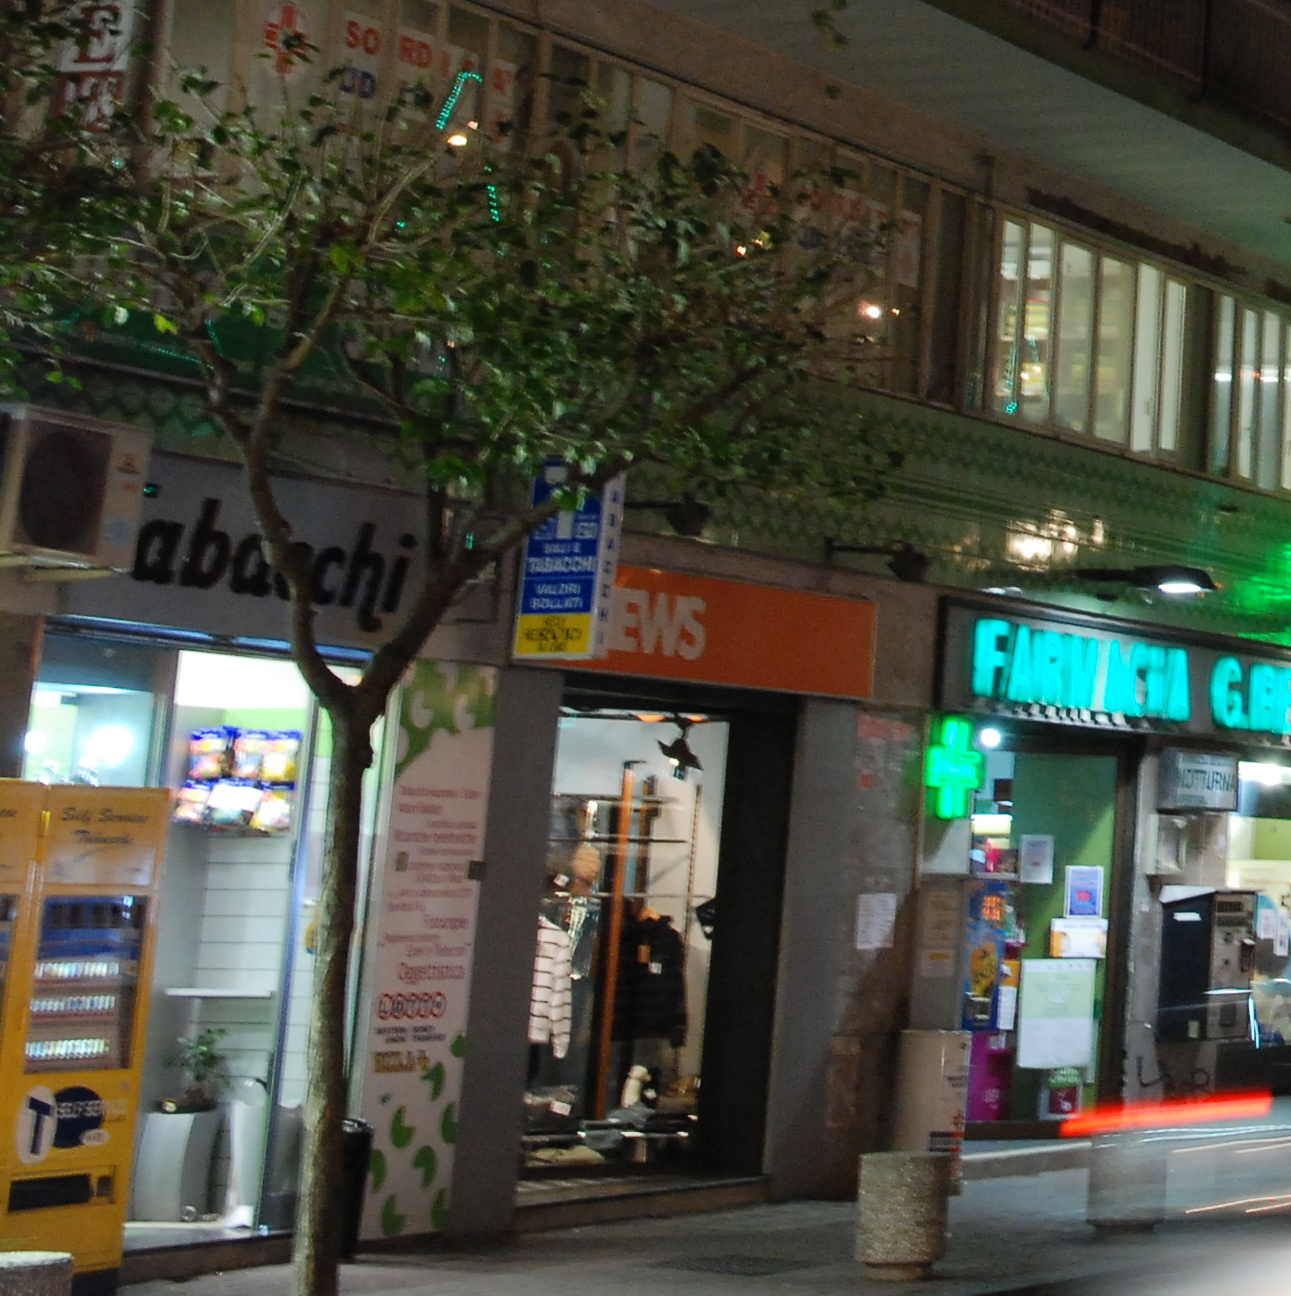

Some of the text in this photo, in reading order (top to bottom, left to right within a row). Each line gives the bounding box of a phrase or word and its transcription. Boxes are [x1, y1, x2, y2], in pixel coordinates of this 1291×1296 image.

[528, 556, 595, 573] TABACCHI
[612, 588, 706, 661] EWS
[972, 617, 1191, 723] FARMACIA
